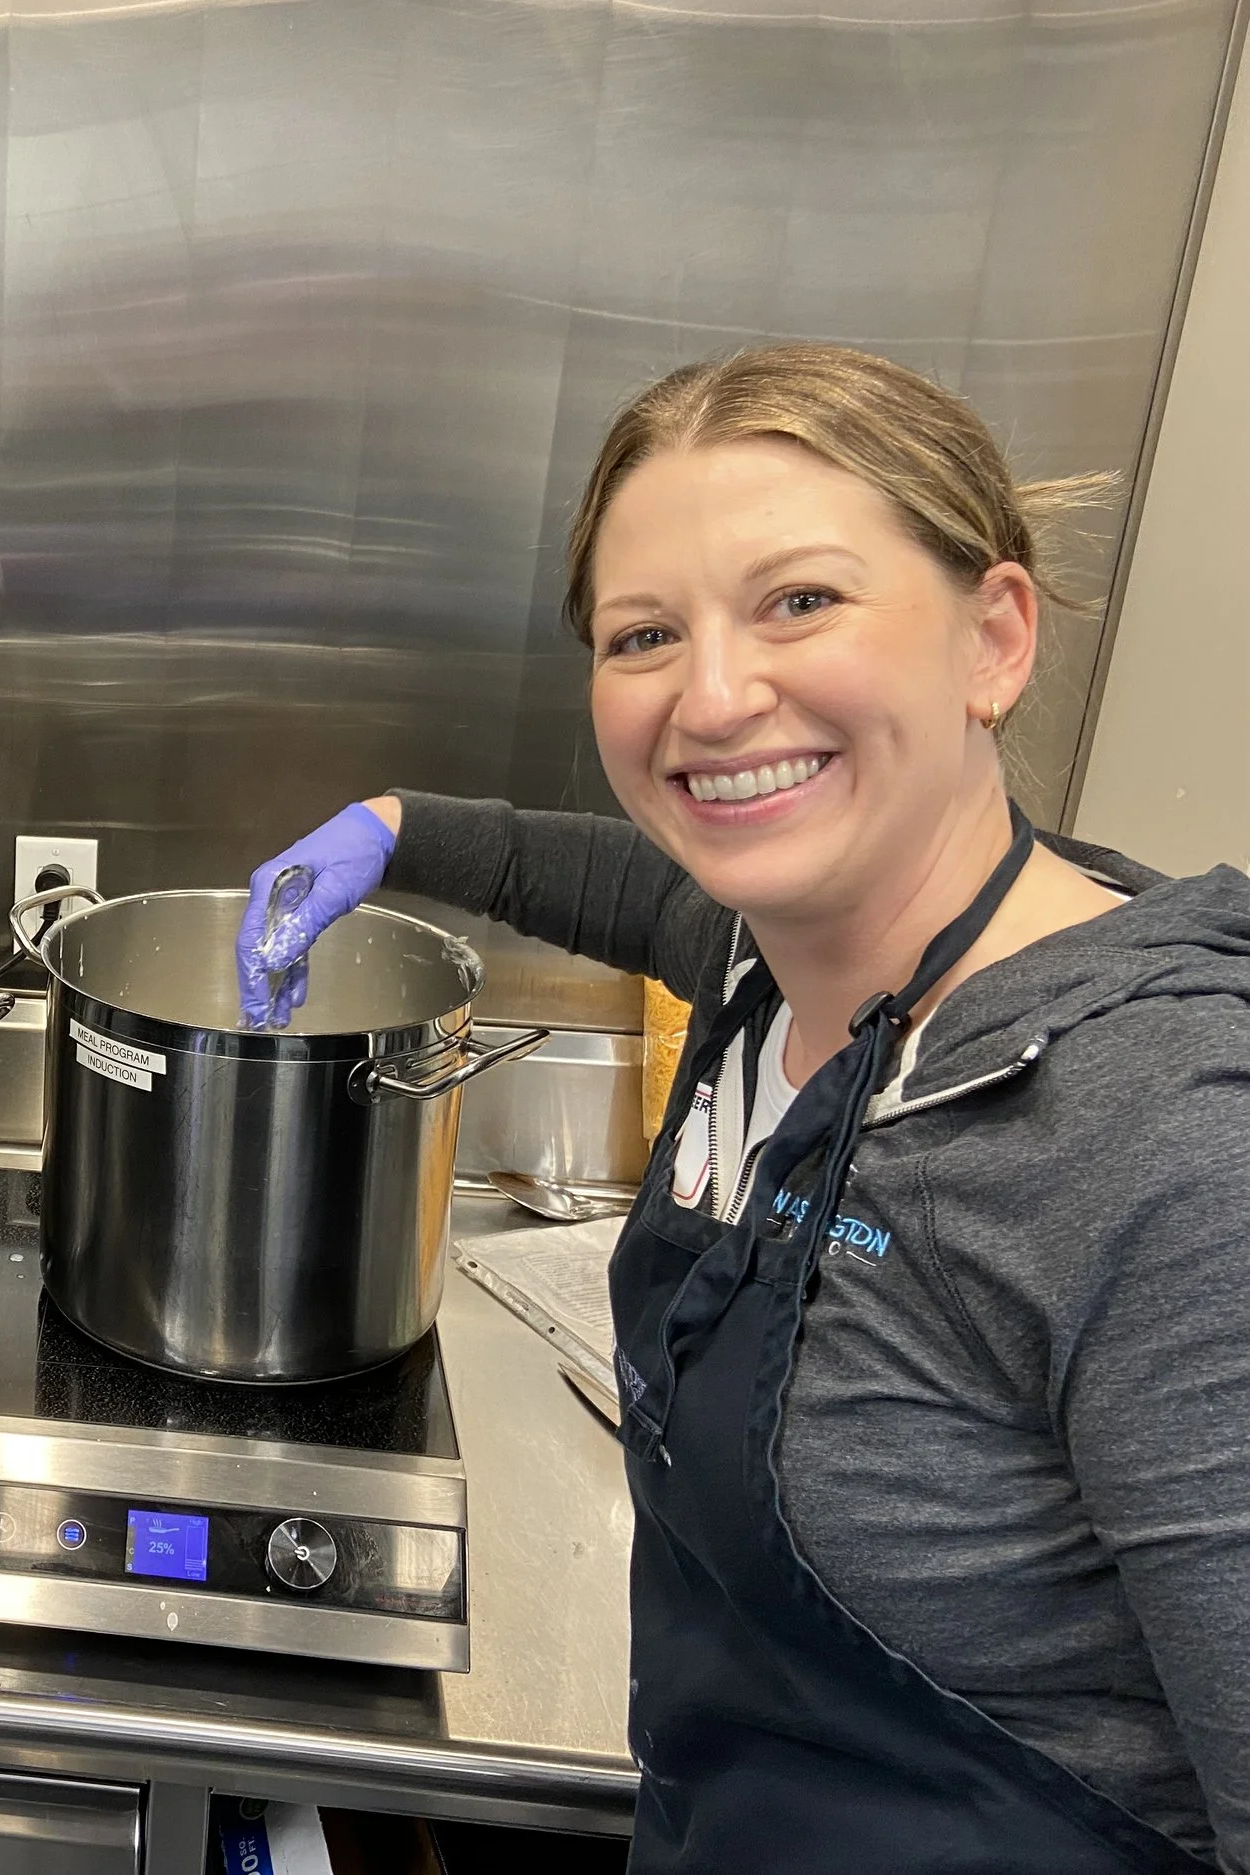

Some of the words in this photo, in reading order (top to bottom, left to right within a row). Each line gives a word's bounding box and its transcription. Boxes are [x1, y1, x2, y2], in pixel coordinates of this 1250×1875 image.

[77, 1027, 98, 1047] MEAL
[100, 1039, 150, 1065] PROGRAM
[87, 1054, 137, 1083] INDUCTION
[149, 1541, 175, 1555] 25%
